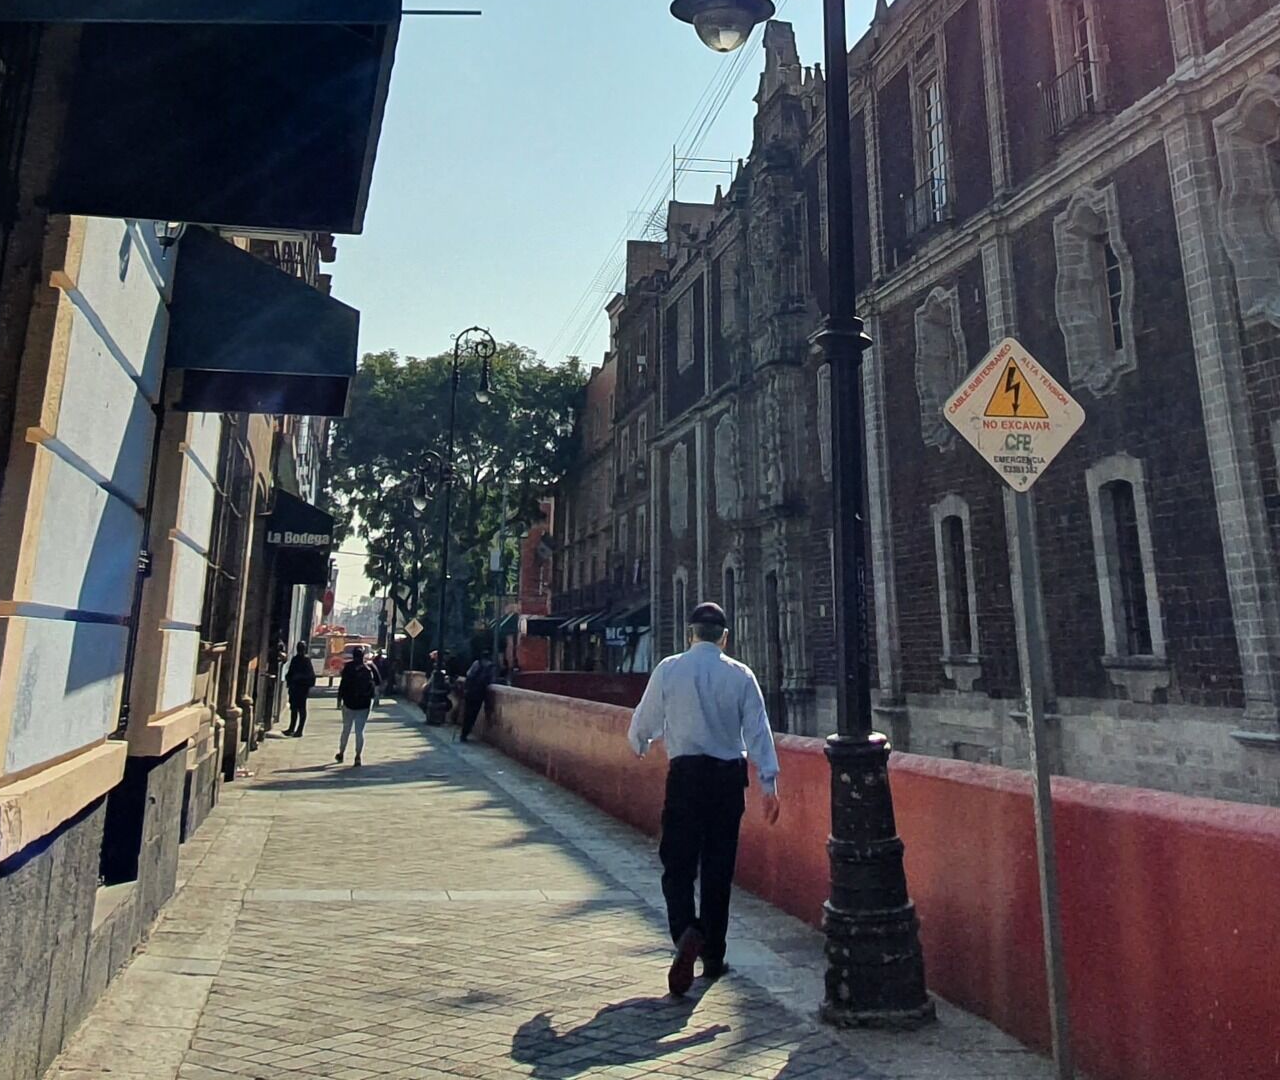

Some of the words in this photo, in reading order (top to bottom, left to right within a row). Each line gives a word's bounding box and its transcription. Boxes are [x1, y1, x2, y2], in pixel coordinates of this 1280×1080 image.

[949, 390, 971, 414] CABLE
[968, 344, 1011, 391] SUBTERRANEO
[1021, 357, 1039, 375] ALTA
[1040, 375, 1068, 405] TENSION
[983, 420, 997, 429] NO
[1001, 420, 1050, 430] EXCAVAR
[267, 531, 281, 543] La
[284, 531, 330, 545] Bodega
